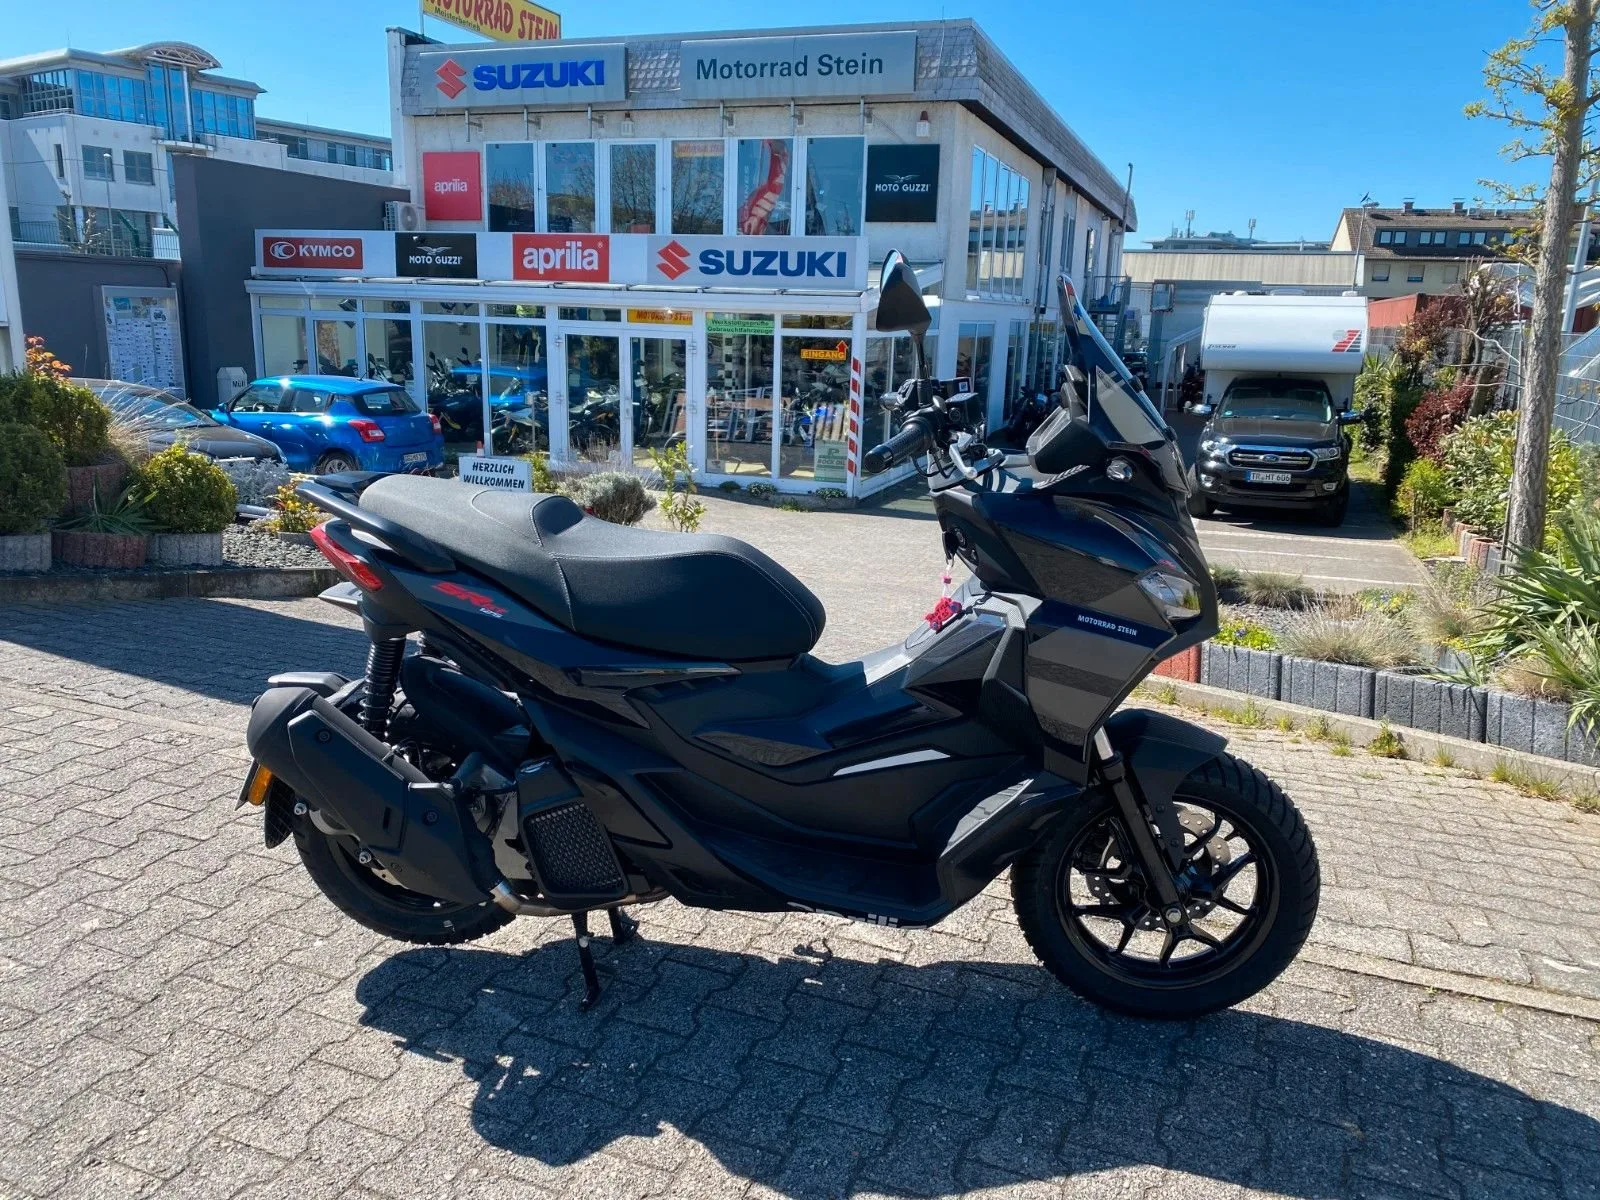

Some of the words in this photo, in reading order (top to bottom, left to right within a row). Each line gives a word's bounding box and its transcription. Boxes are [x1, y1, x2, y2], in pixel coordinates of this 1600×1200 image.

[434, 7, 481, 31] Meisterbetrieb
[518, 9, 557, 40] STEIN
[473, 60, 605, 91] SUZUKI
[696, 55, 808, 80] Motorrad
[817, 52, 883, 76] Stein
[434, 178, 468, 194] aprilia
[875, 183, 900, 192] MOTO
[902, 183, 929, 192] GUZZI
[298, 244, 355, 258] KYMCO
[409, 255, 433, 264] MOTO
[435, 255, 461, 265] GUZZI
[522, 240, 599, 274] aprilia
[698, 249, 847, 278] SUZUKI
[803, 350, 845, 359] EINGANG
[472, 461, 515, 475] HERZLICH
[463, 474, 525, 489] WILLKOMMEN
[1077, 614, 1116, 630] MOTORRAD
[1117, 625, 1137, 636] STEIN
